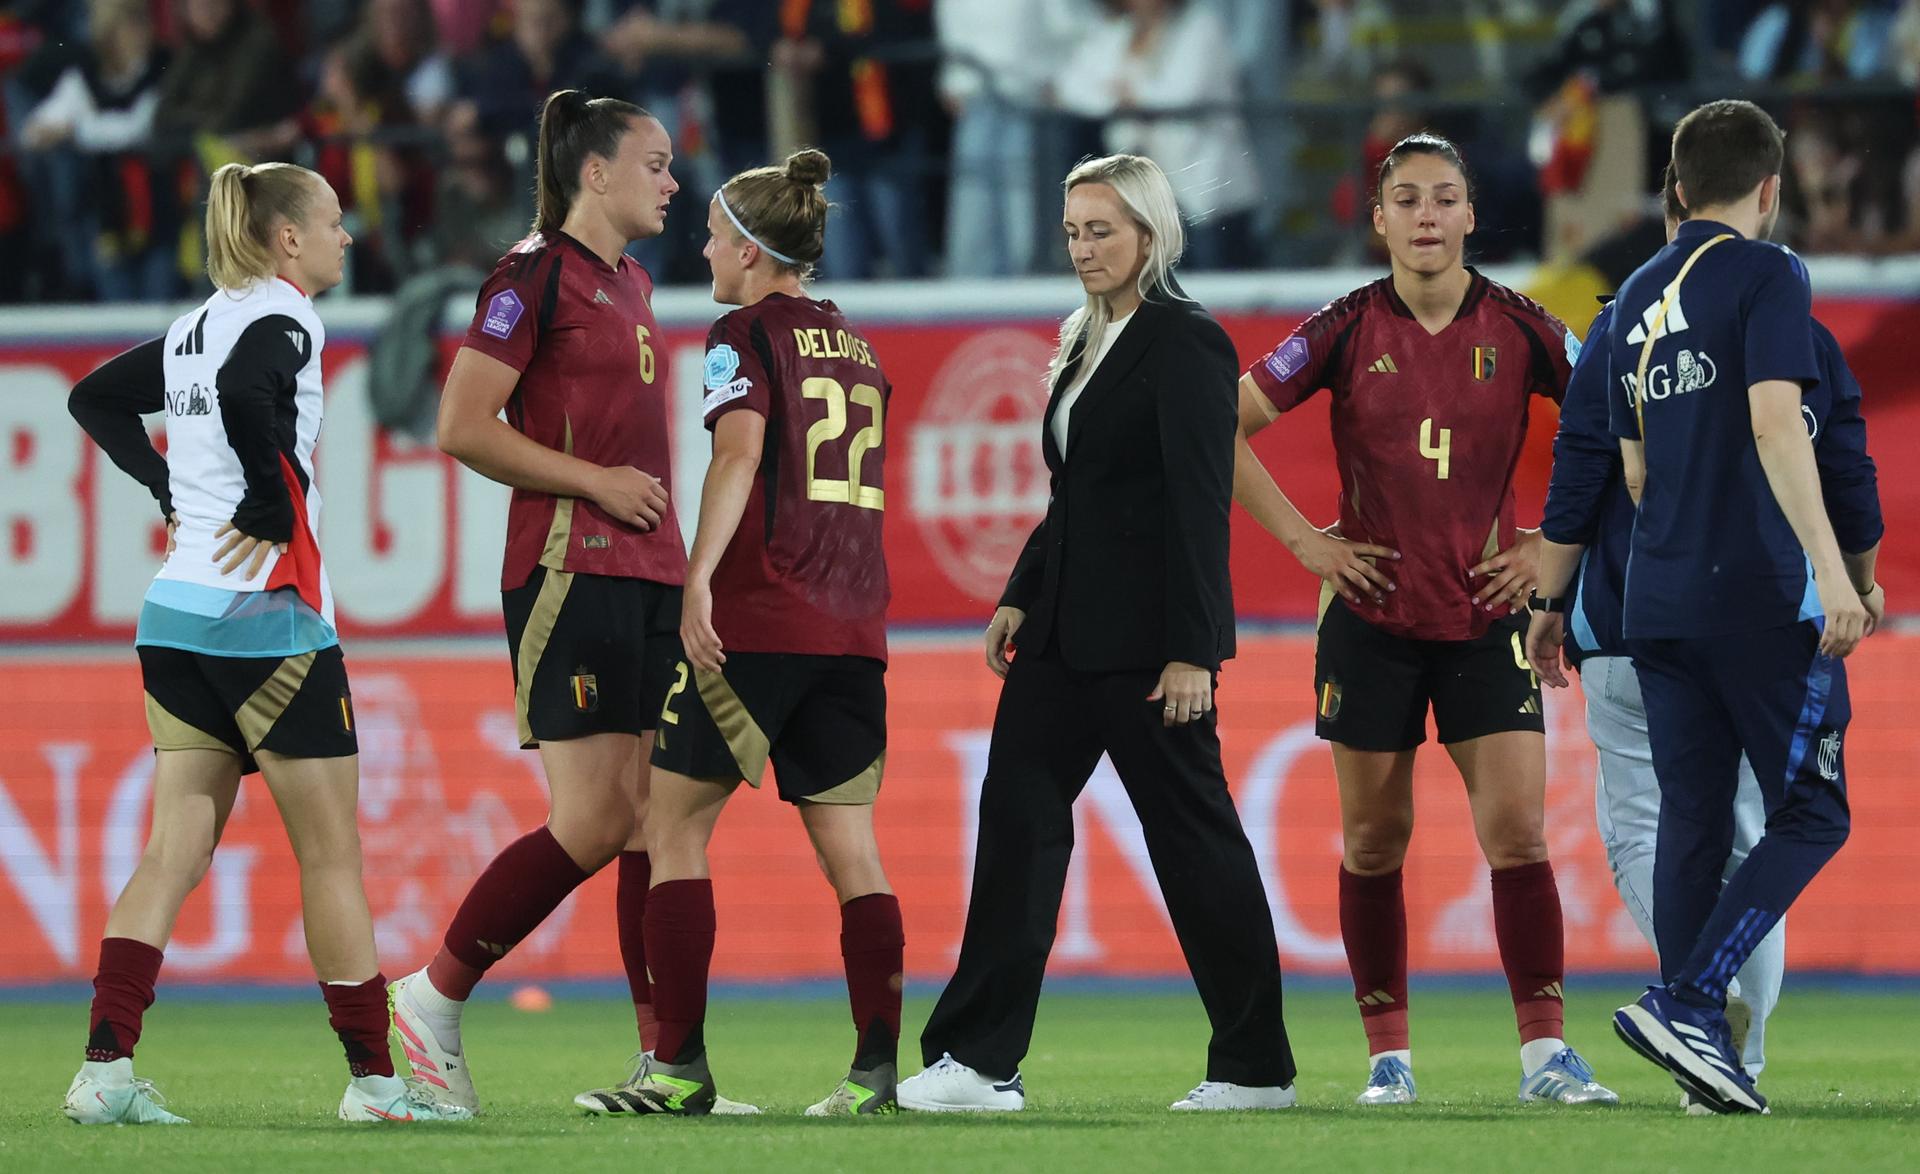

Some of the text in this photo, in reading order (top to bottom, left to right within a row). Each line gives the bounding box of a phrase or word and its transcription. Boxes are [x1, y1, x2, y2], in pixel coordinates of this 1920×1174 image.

[636, 324, 655, 384] 6
[793, 328, 876, 369] DELOOSE
[165, 390, 185, 417] NG
[1621, 363, 1672, 408] ING
[801, 377, 885, 511] 22
[1420, 417, 1451, 479] 4
[0, 742, 258, 970] NG
